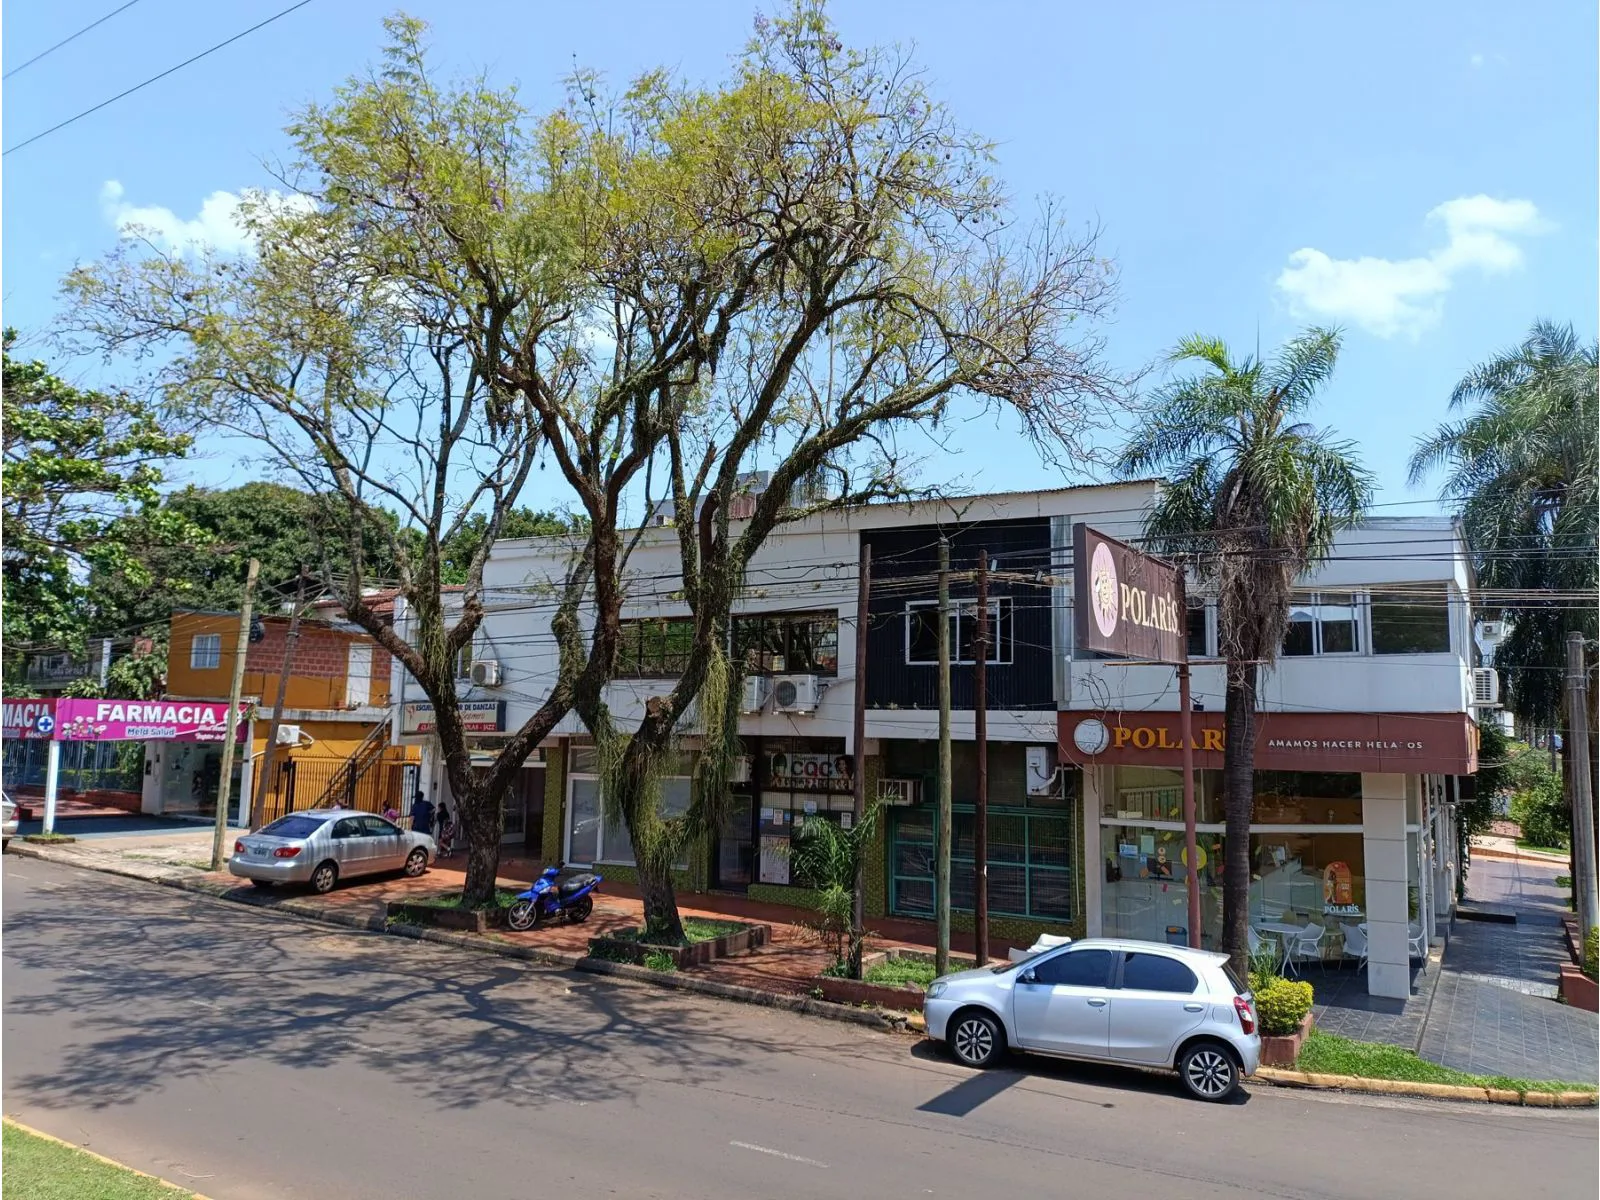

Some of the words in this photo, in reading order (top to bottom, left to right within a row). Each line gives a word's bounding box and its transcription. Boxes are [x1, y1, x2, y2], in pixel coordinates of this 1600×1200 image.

[97, 704, 216, 724] FARMACIA
[1113, 723, 1226, 752] POLAR
[1268, 739, 1318, 748] AMAMOS
[1322, 740, 1361, 748] HACER
[1366, 741, 1423, 749] HELAOS
